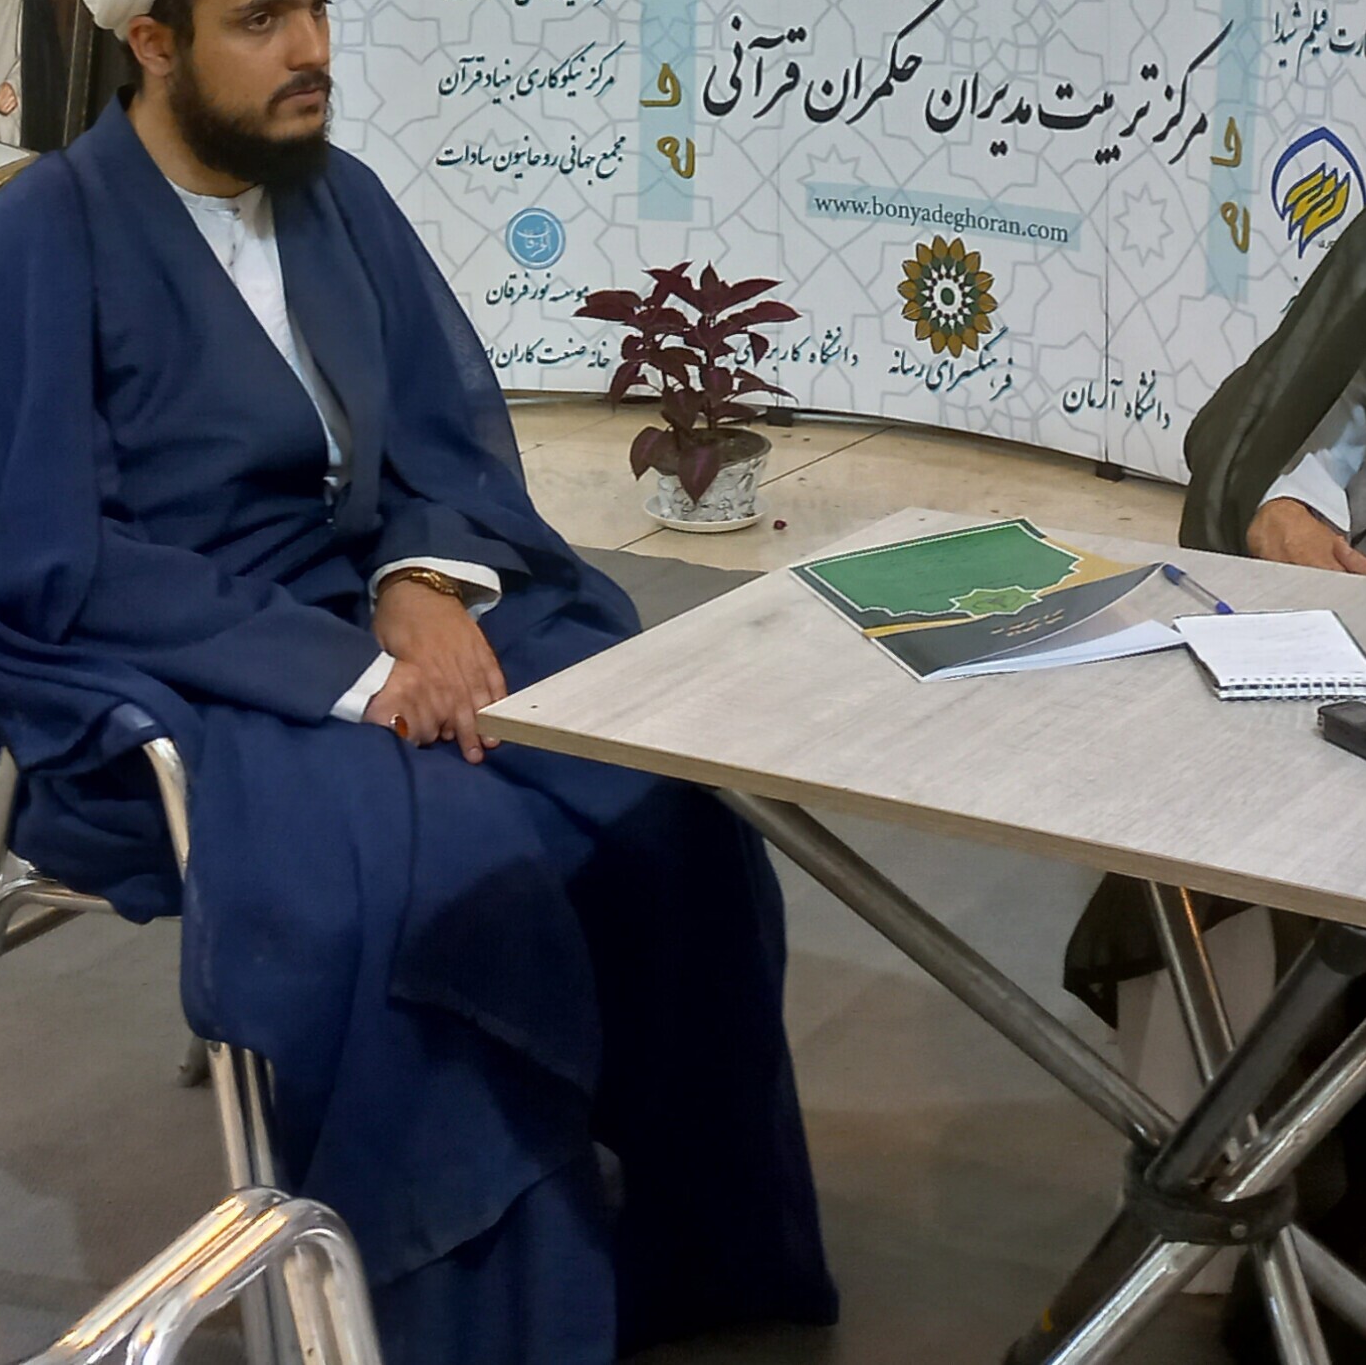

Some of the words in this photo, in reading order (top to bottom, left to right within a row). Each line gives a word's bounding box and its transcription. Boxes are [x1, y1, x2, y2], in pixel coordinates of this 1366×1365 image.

[438, 55, 486, 96] قرآن
[515, 41, 597, 98] نیکوکاری
[584, 40, 627, 98] مرکز
[702, 15, 810, 120] قرآنی
[1152, 19, 1235, 166] مرکز
[923, 71, 1033, 158] مدیران
[1036, 62, 1159, 165] تربیت
[435, 145, 492, 167] سادات
[813, 195, 1070, 245] www.bonyadeghoran.com
[485, 272, 531, 305] فرقان
[529, 272, 551, 301] نور
[495, 337, 545, 369] کاران
[536, 338, 587, 365] صنعت
[587, 341, 612, 369] خانه
[809, 326, 860, 367] دانشگاه
[887, 349, 926, 380] رسانه
[1123, 369, 1172, 431] دانشگاه
